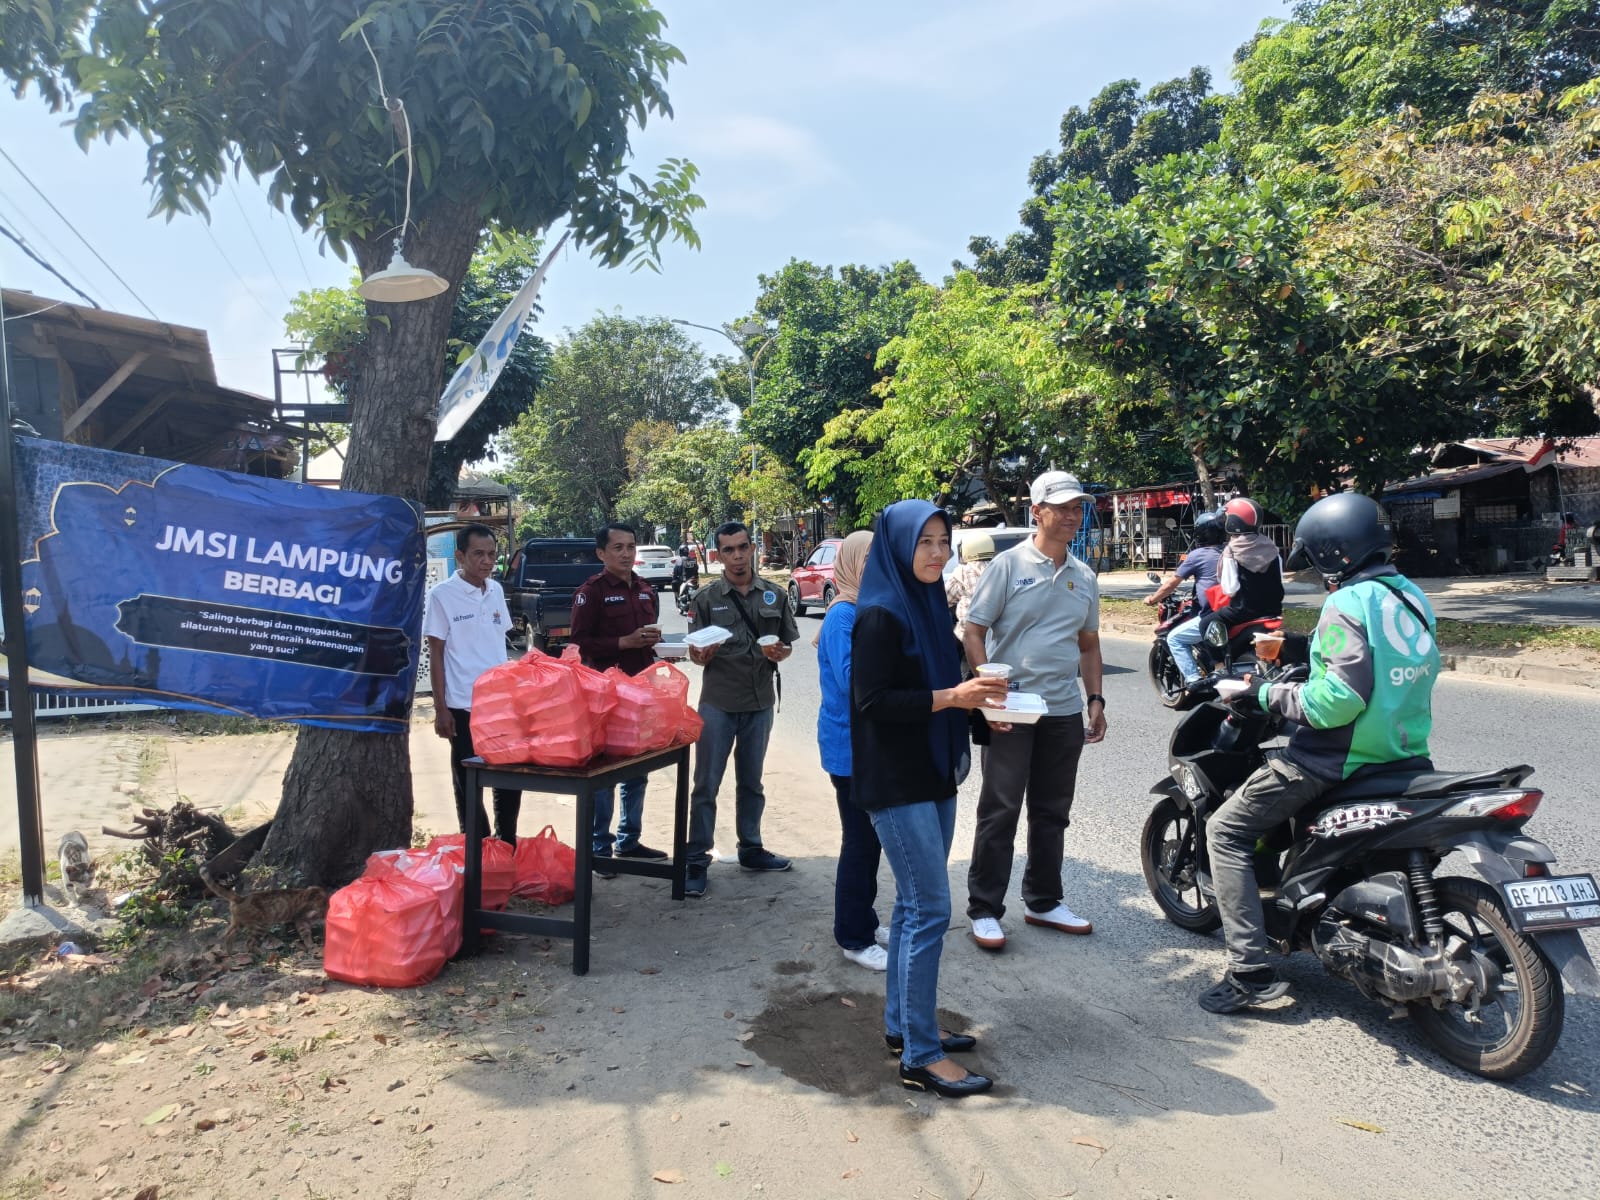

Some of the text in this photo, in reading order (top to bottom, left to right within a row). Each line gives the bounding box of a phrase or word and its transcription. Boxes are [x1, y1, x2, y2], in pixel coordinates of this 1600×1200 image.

[155, 525, 403, 585] JMSI LAMPUNG
[223, 570, 342, 605] BERBAGI
[180, 621, 364, 653] silaturahmi untuk meraih kemenangan
[199, 611, 352, 639] "Saling berbagi dan menguatkan
[250, 643, 299, 655] yang suci"
[1390, 663, 1431, 686] gojk
[1325, 805, 1392, 829] STREET
[1511, 882, 1596, 906] BE 2213 AHJ
